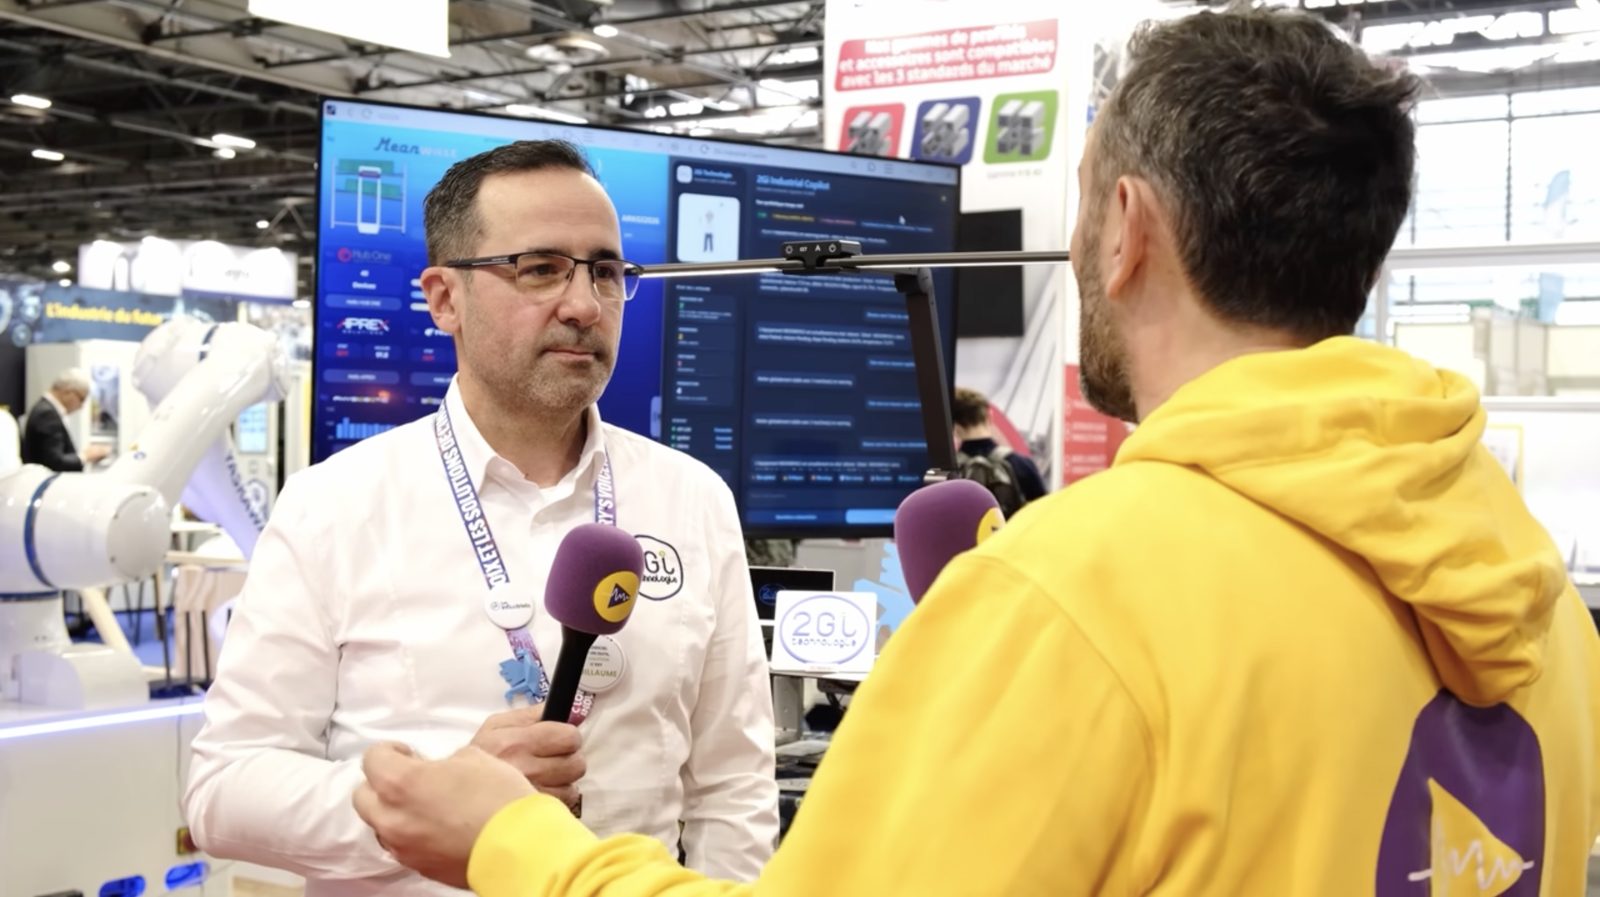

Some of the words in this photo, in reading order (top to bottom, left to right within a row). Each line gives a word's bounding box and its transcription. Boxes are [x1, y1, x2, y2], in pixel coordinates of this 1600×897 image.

[950, 29, 969, 46] de
[840, 58, 855, 73] et
[856, 51, 932, 70] accessoires
[934, 47, 966, 63] sont
[967, 37, 1055, 60] compatibles
[841, 73, 872, 89] avec
[874, 69, 895, 84] les
[896, 69, 905, 82] 3
[907, 62, 975, 81] standards
[976, 61, 996, 75] du
[997, 54, 1053, 74] marché
[371, 250, 392, 261] One
[815, 244, 822, 252] A
[443, 447, 482, 521] SOLUTIONS
[466, 517, 494, 548] LES
[483, 559, 509, 587] OIX
[643, 550, 676, 575] Gi
[584, 669, 618, 679] ILLAUME
